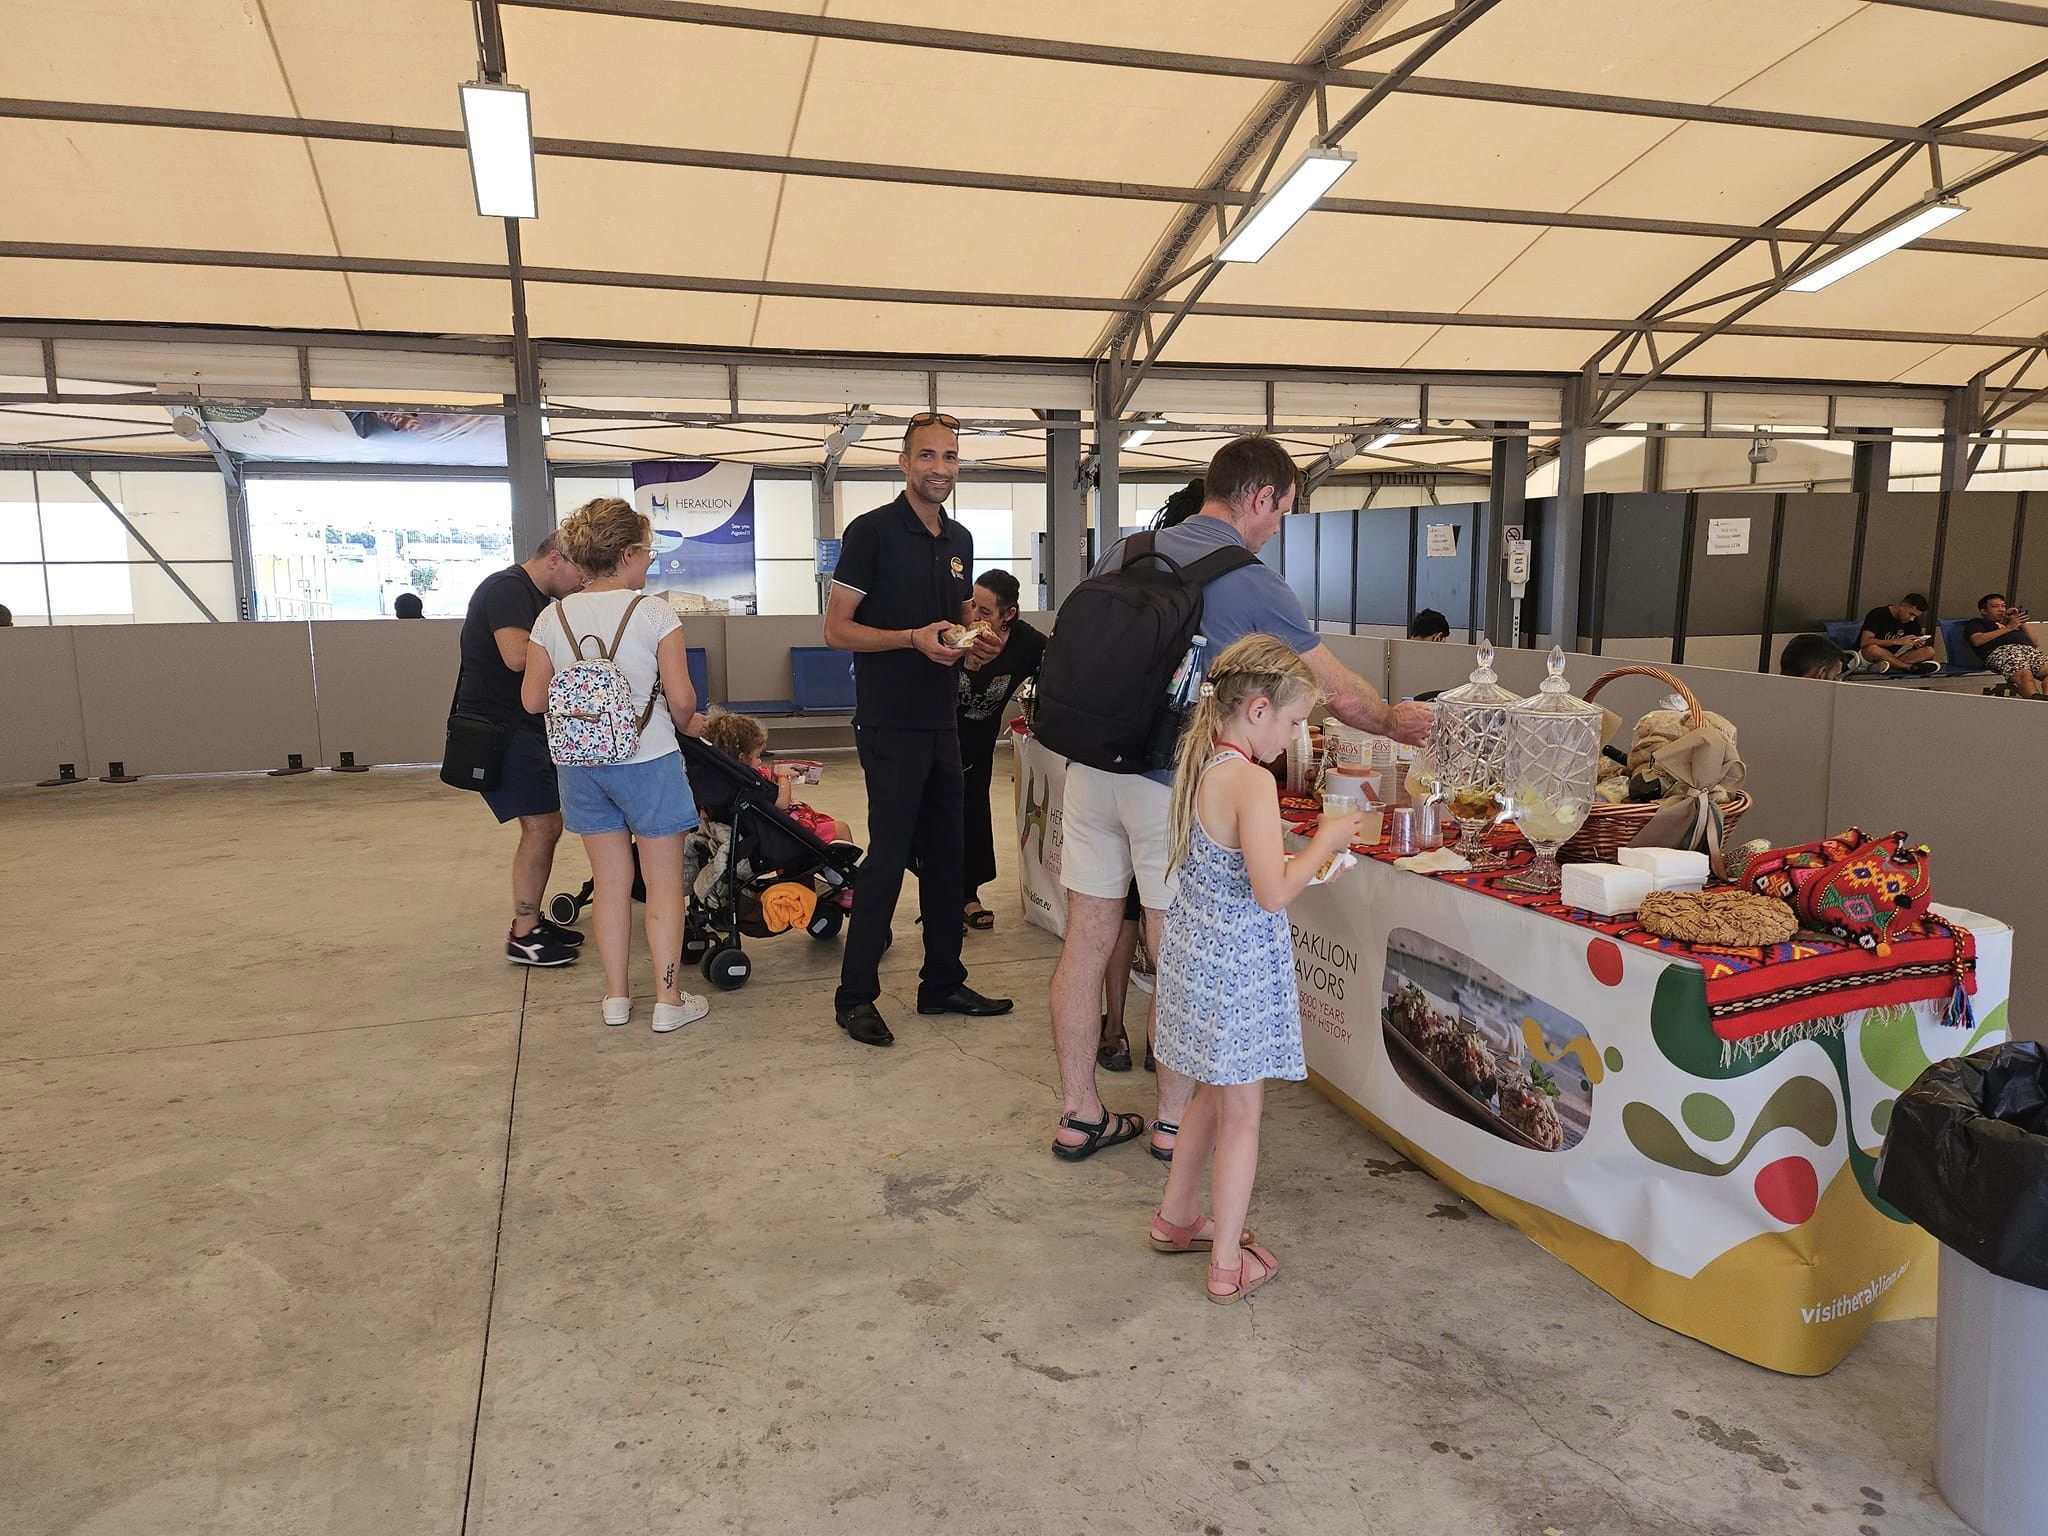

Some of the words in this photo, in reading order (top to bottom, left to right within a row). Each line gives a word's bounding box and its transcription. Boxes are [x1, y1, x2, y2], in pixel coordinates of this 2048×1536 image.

[676, 498, 732, 509] HERAKLION
[1289, 923, 1358, 975] RAKLION
[1299, 990, 1317, 1010] 5000
[1319, 1000, 1345, 1025] YEARS
[1318, 1017, 1352, 1045] HISTORY
